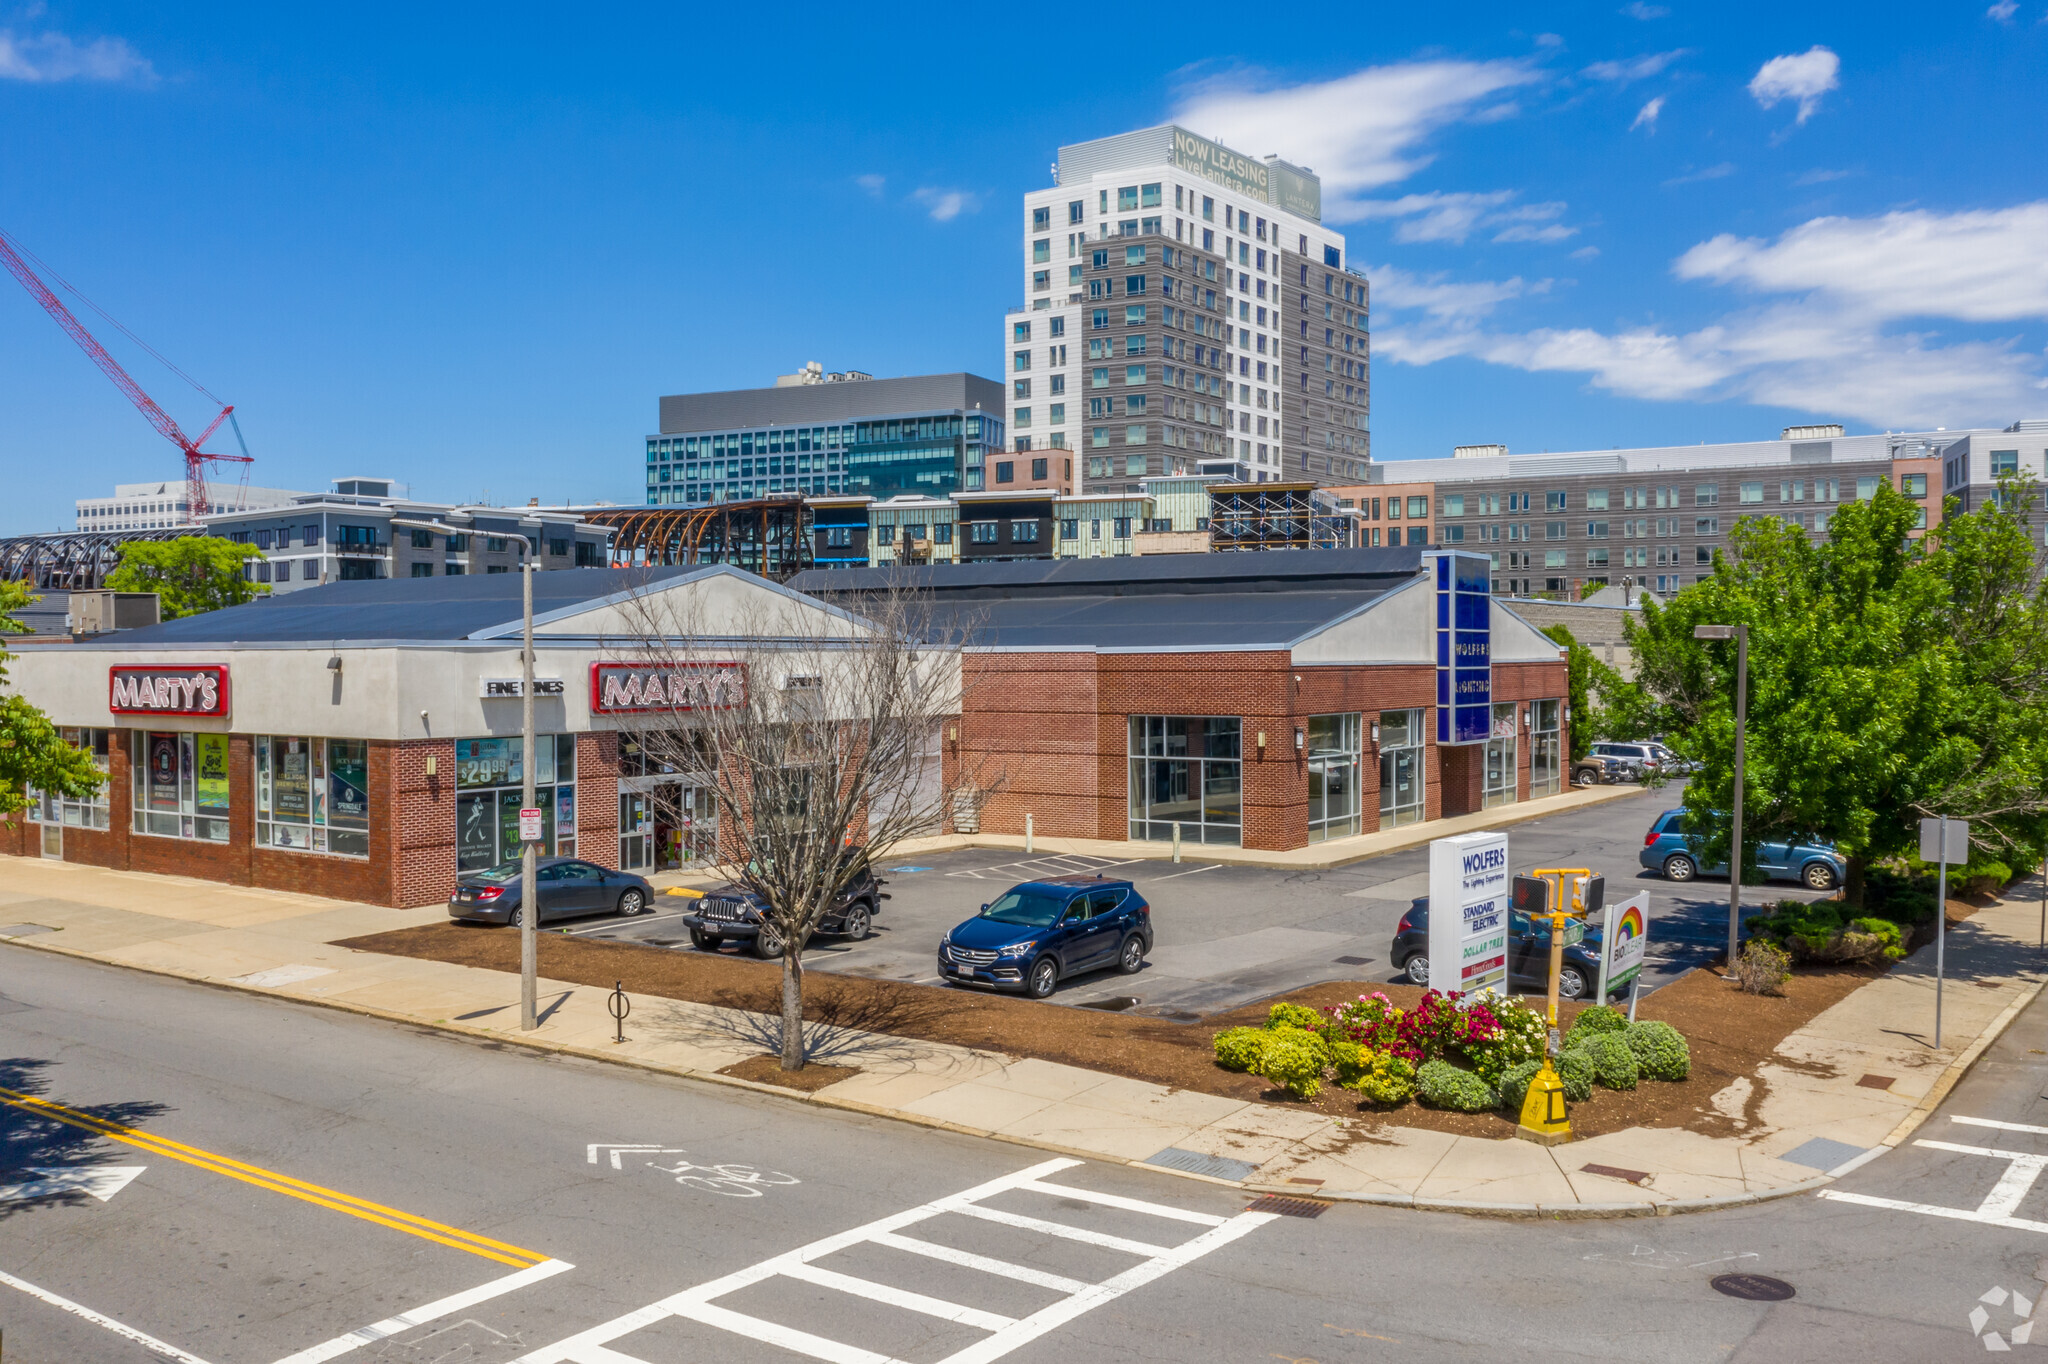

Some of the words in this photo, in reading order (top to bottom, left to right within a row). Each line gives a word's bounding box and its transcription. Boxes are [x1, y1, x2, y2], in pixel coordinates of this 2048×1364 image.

[1175, 132, 1209, 162] NOW
[1211, 147, 1267, 187] LEASING
[1175, 151, 1268, 203] LiveLantera.com
[1455, 643, 1490, 656] WOLFERS
[111, 672, 217, 710] MARTY'S
[487, 681, 519, 694] FINE
[521, 680, 564, 693] INES
[602, 669, 744, 706] MARTY'S
[1455, 680, 1490, 693] LIGHTING
[337, 802, 362, 810] SPRINGDALE
[1463, 847, 1505, 875] WOLFERS
[1471, 877, 1484, 889] Lighting
[1486, 873, 1504, 884] Experience
[1464, 901, 1494, 919] STANDARD
[1473, 914, 1498, 931] ELECTRIC
[1463, 941, 1487, 959] DOLLAR
[1489, 936, 1504, 951] TREE
[1613, 936, 1642, 962] BIOCLEAR
[1471, 958, 1496, 976] HomeGoods
